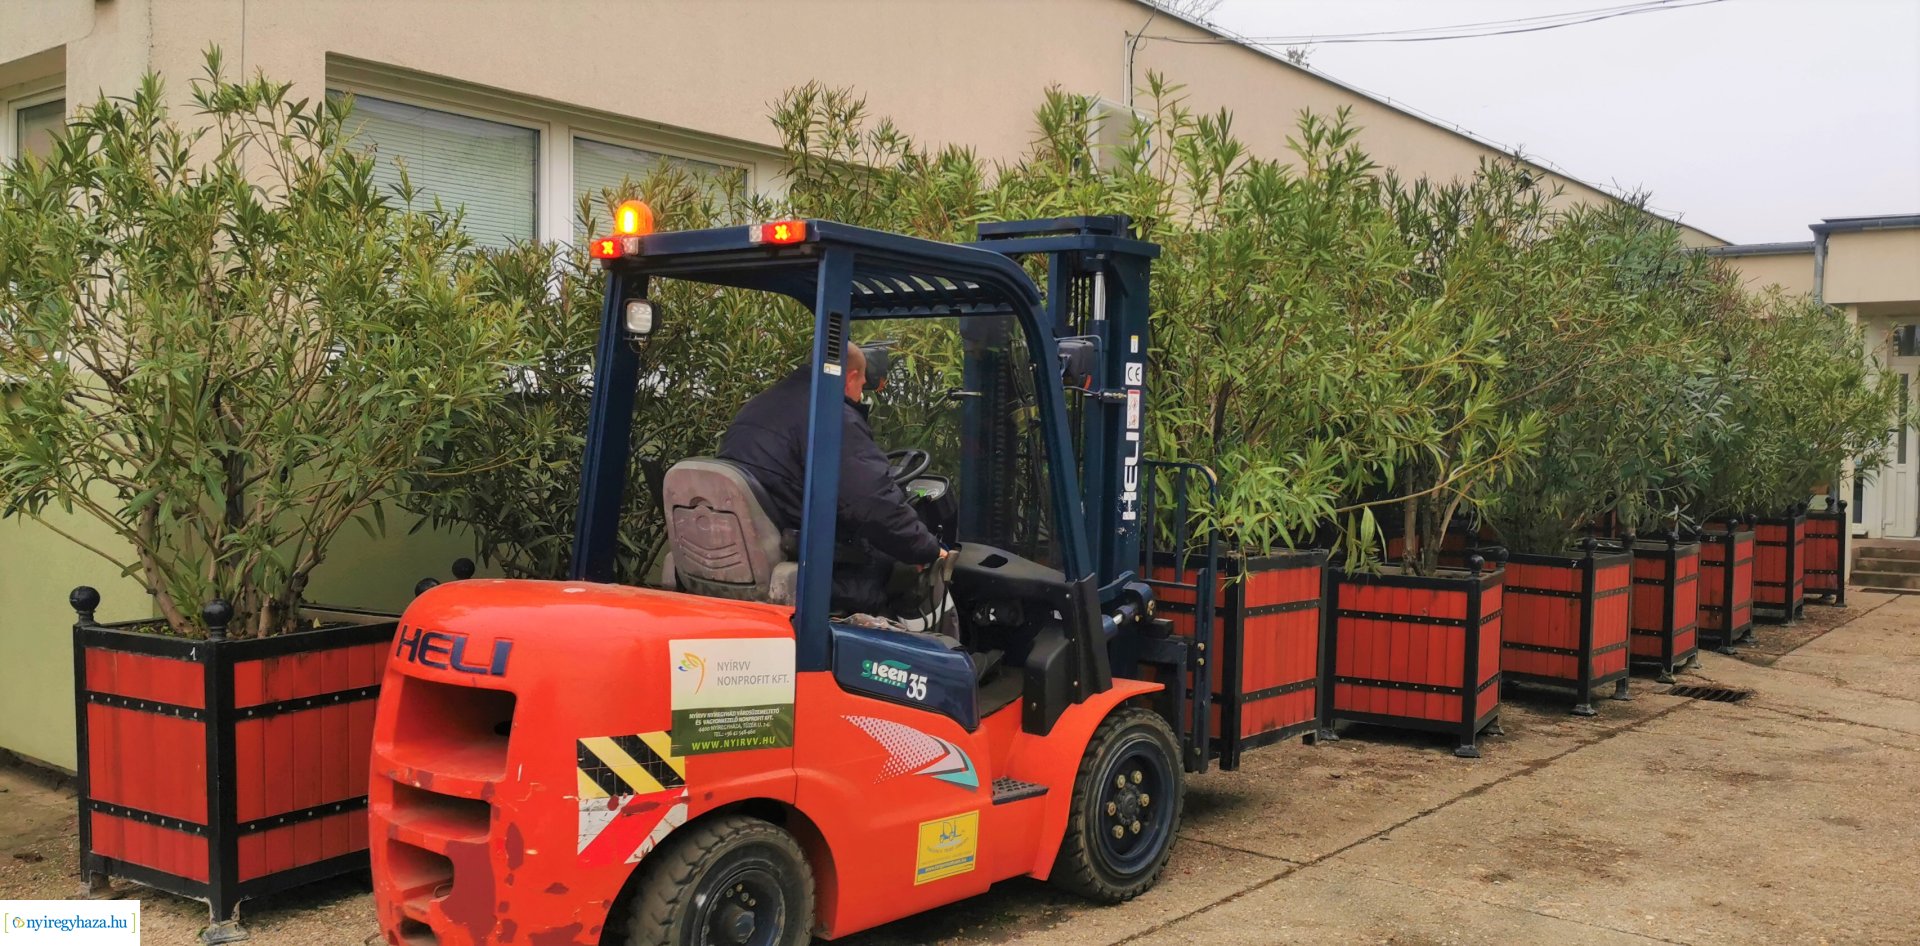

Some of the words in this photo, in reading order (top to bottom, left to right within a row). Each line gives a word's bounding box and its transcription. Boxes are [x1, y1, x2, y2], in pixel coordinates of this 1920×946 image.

[1122, 432, 1140, 520] HELI
[396, 625, 513, 676] HELI
[717, 660, 751, 672] NYÍRVV
[717, 674, 770, 686] NONPROFIT
[772, 674, 790, 684] KFT.
[906, 674, 927, 700] 35
[691, 736, 776, 751] WWW.NYIRVV.HU
